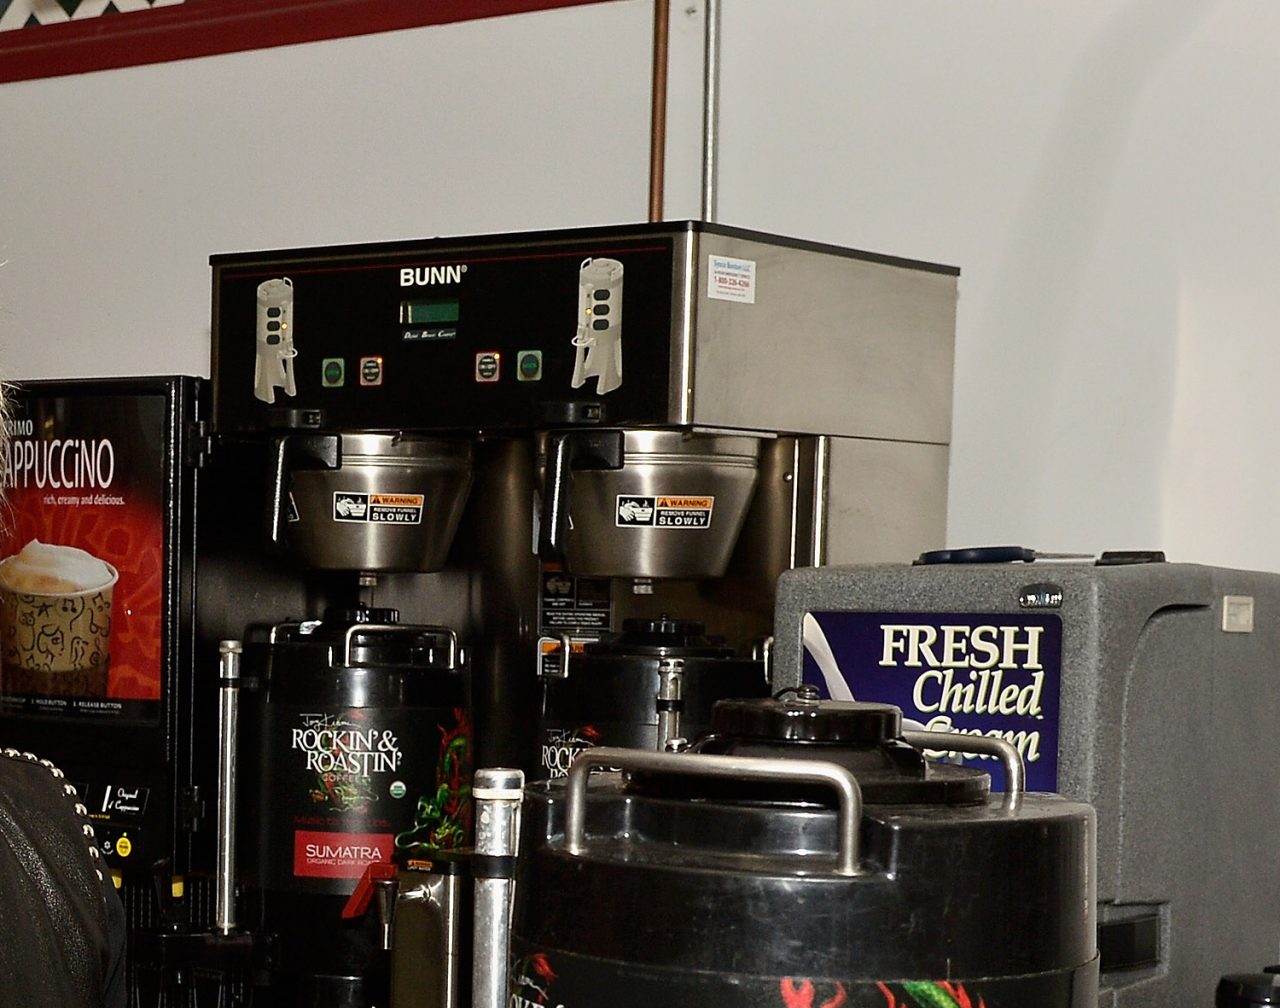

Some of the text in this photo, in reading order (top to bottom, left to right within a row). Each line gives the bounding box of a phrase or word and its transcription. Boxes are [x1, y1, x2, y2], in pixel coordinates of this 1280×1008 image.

[1, 438, 115, 489] APPUCCiNO
[58, 496, 80, 507] creamy
[81, 494, 93, 505] and
[94, 494, 125, 505] delicious.
[372, 513, 417, 521] SLOWLY
[659, 516, 706, 525] SLOWLY
[878, 624, 1044, 670] FRESH
[912, 668, 1045, 717] Chilled
[291, 728, 399, 753] ROCKIN' &
[305, 844, 382, 860] SUMATRA
[306, 857, 381, 868] ORGANIC DARK ROA
